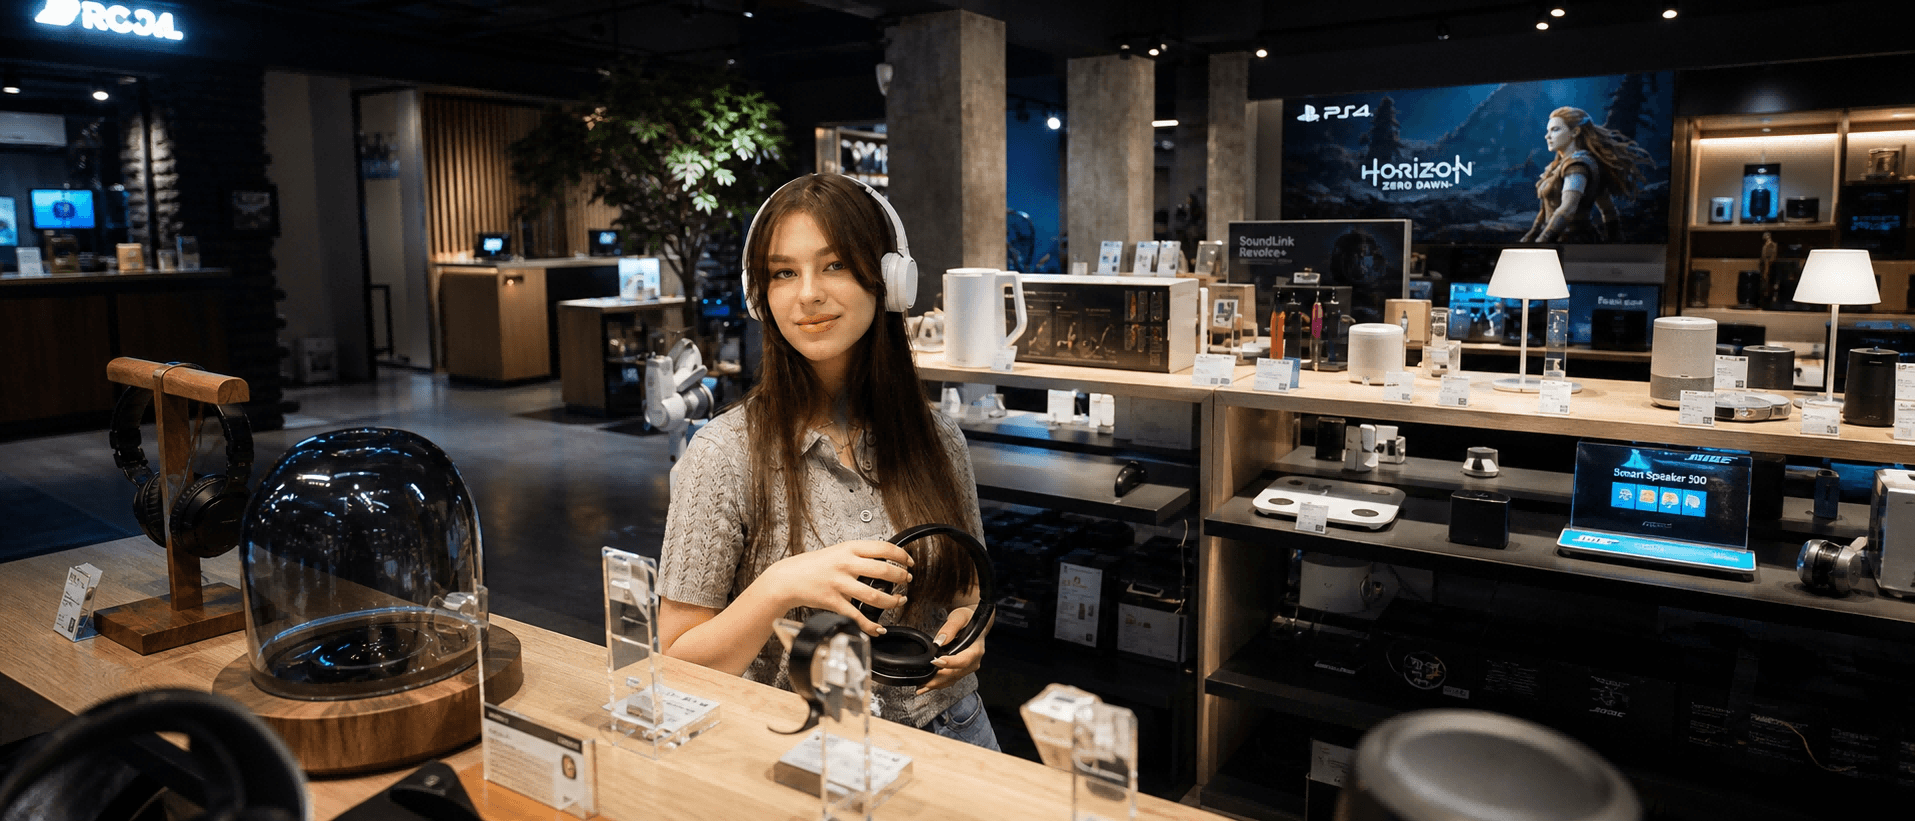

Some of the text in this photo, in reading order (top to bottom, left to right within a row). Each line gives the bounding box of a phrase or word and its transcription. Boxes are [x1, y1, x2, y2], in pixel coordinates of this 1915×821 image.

[1323, 104, 1371, 120] PS4
[1361, 154, 1473, 187] HORIZON
[1381, 180, 1449, 191] ZERO DAWN
[1239, 235, 1295, 247] SoundLink
[1646, 471, 1687, 482] Speaker
